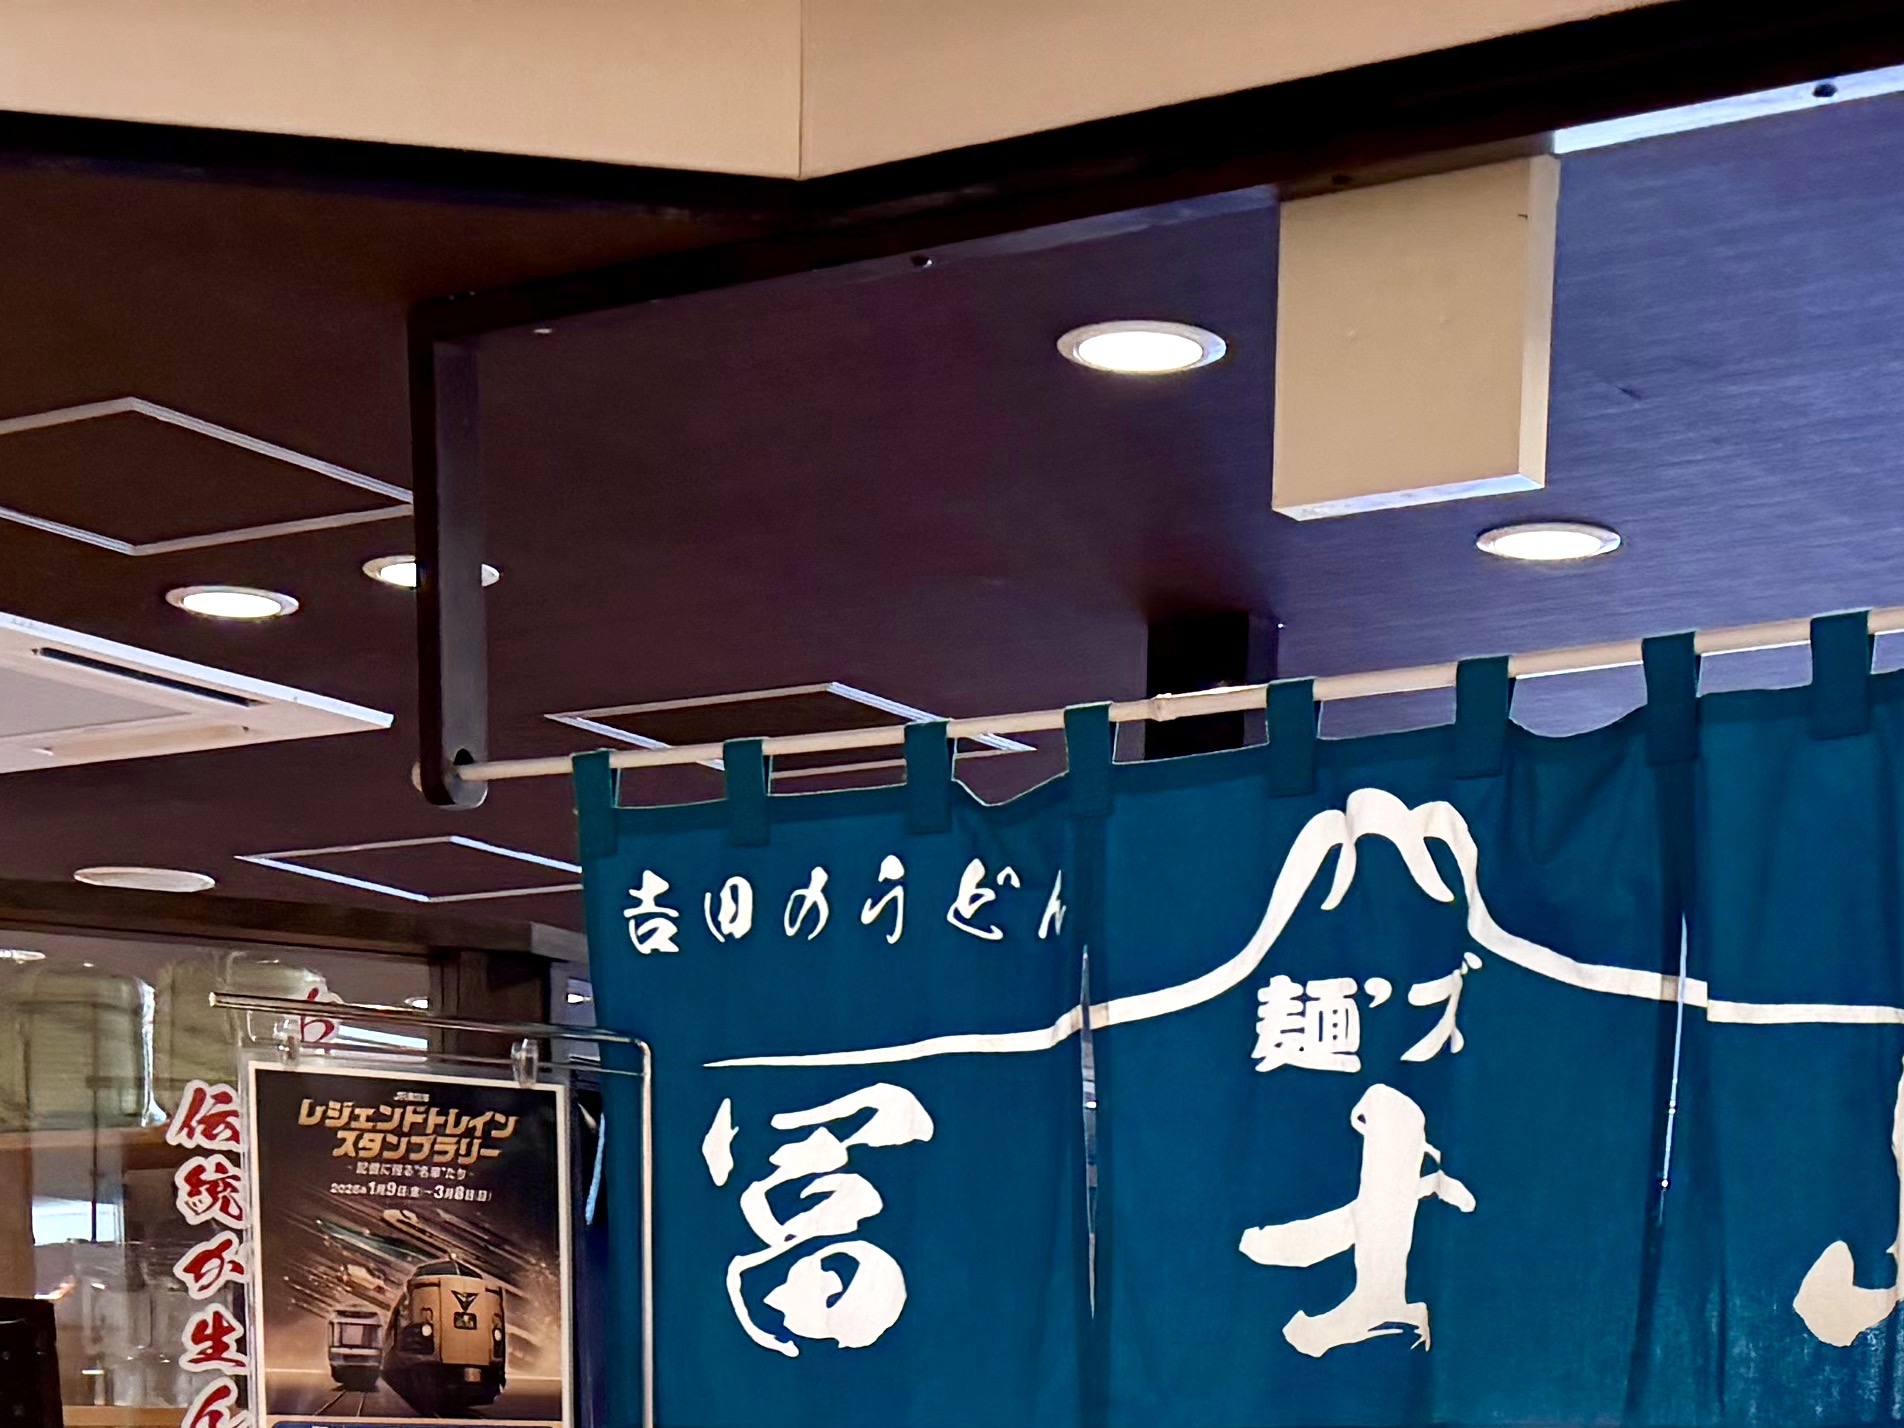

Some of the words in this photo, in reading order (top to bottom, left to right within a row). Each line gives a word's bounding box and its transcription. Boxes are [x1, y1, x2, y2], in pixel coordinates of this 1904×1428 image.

[298, 1098, 519, 1139] レジェンドトレイン
[332, 1130, 502, 1165] スタンプラリー
